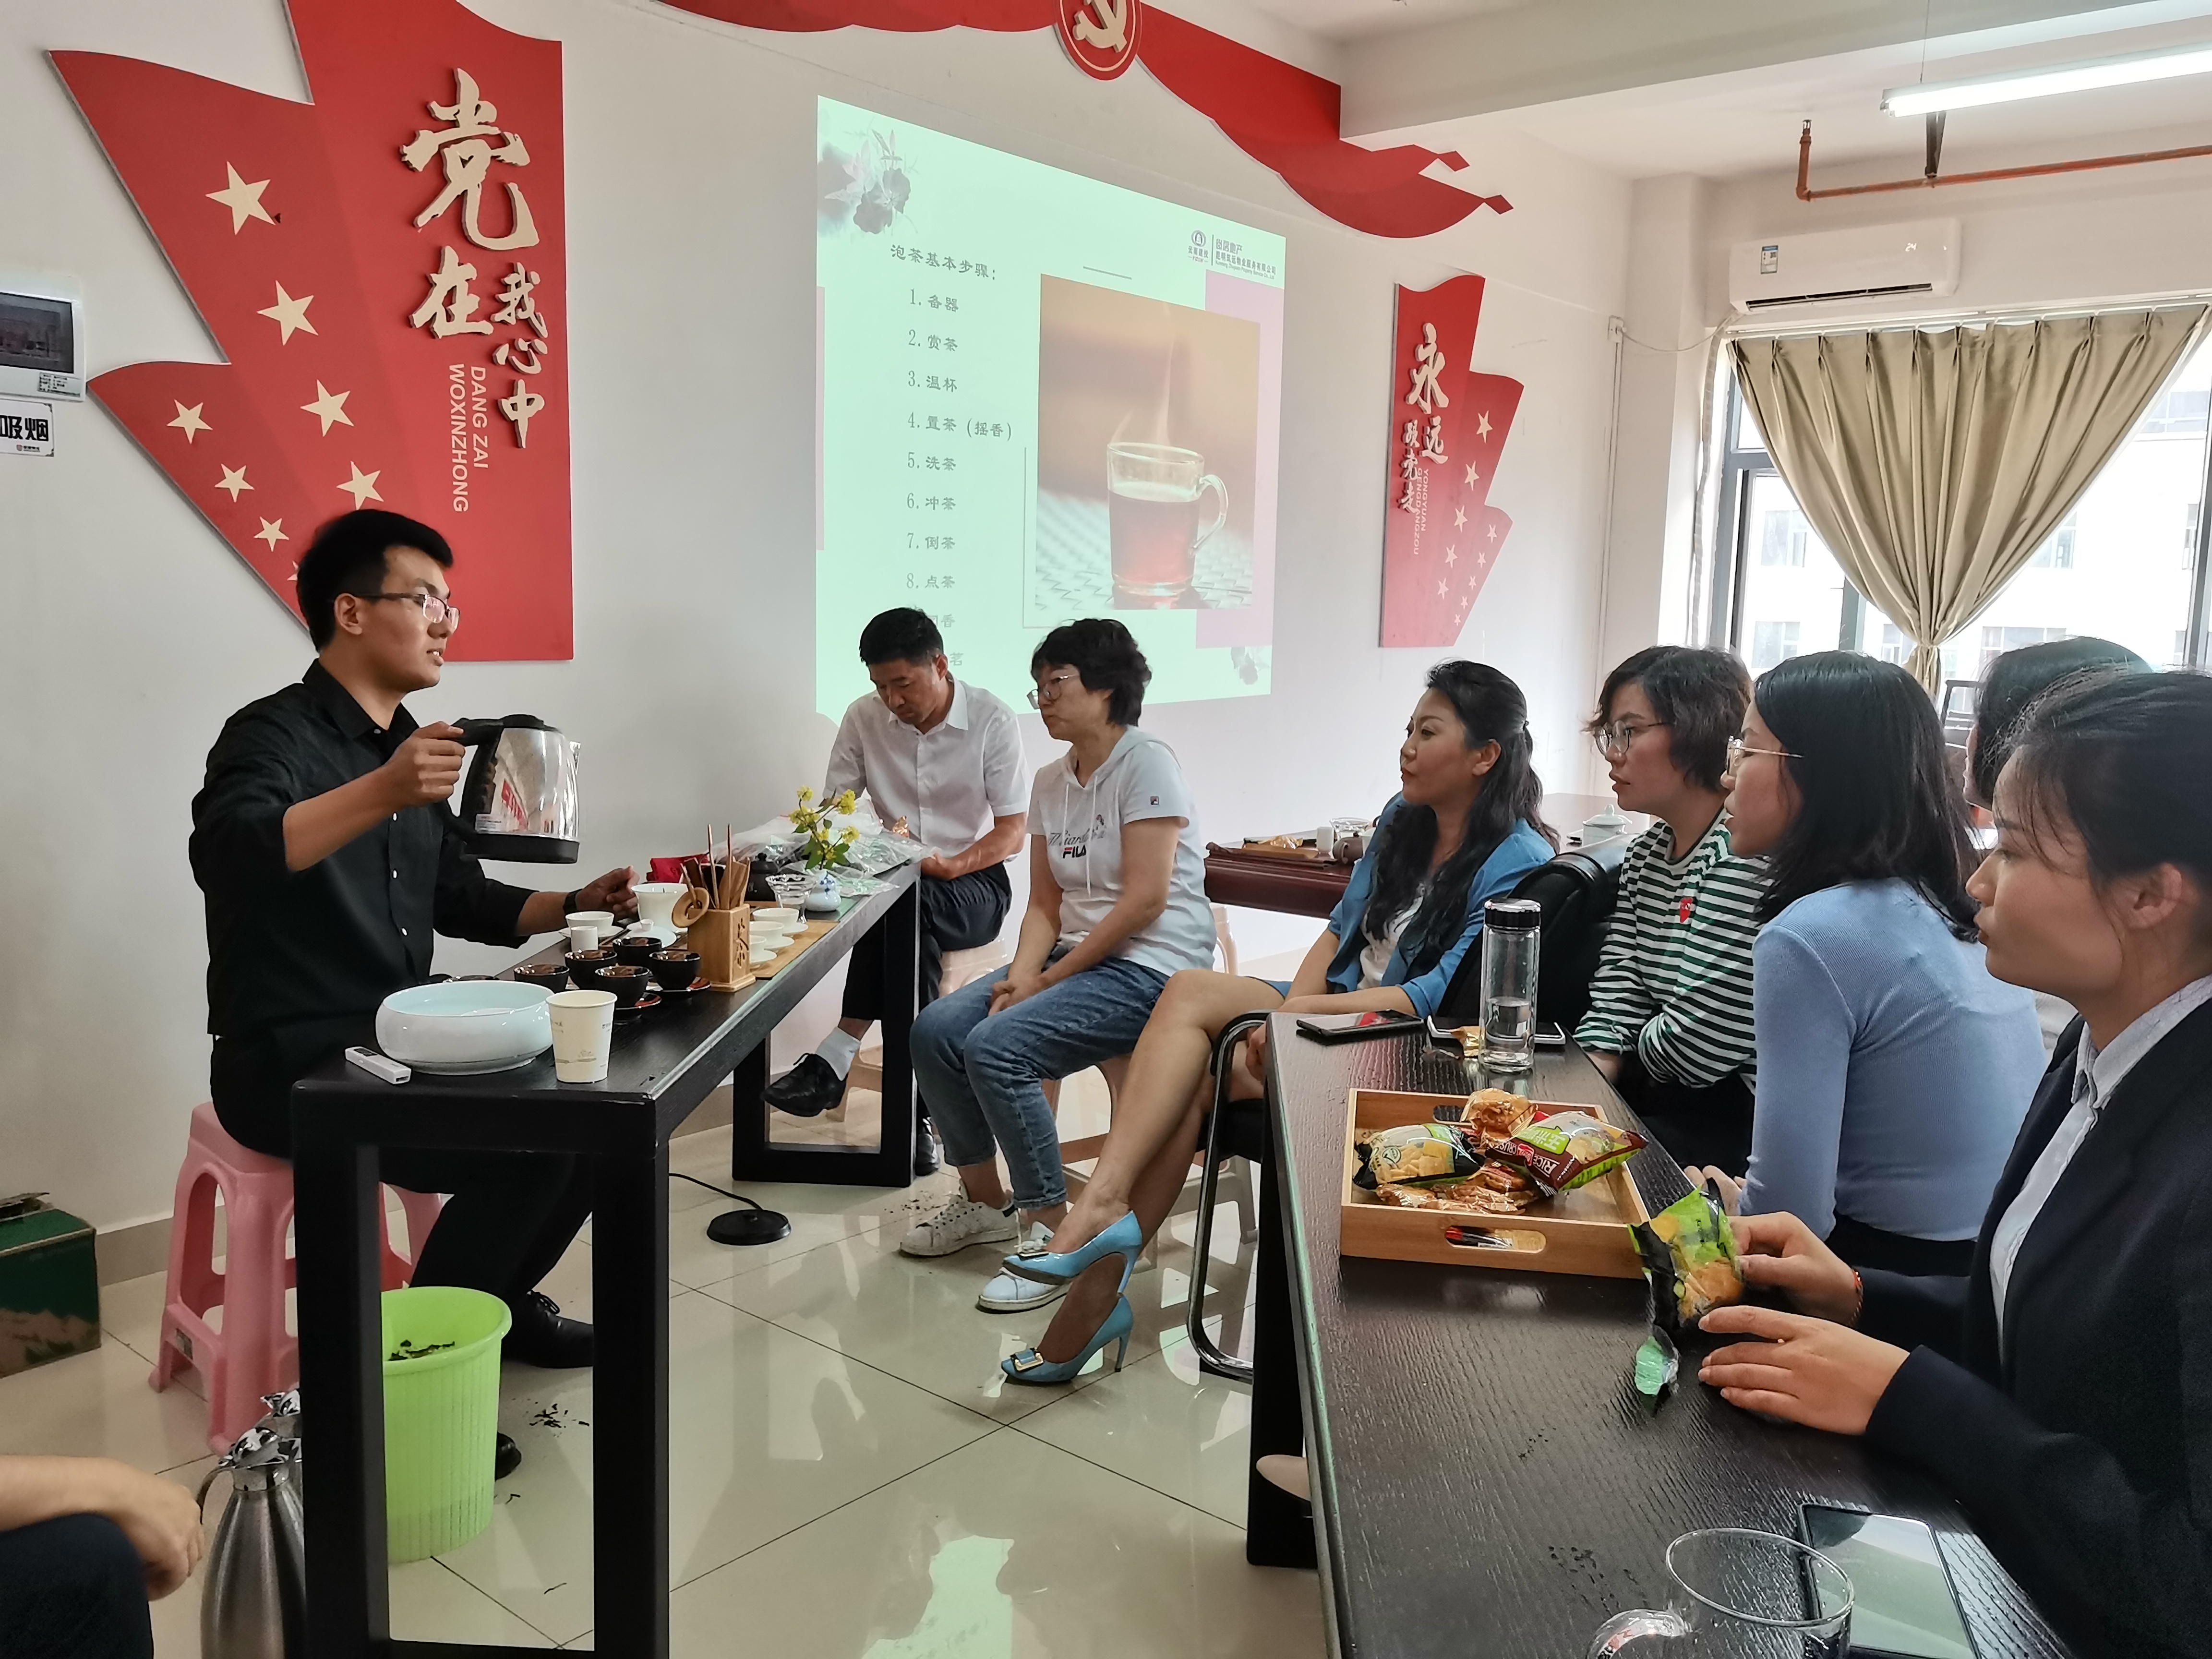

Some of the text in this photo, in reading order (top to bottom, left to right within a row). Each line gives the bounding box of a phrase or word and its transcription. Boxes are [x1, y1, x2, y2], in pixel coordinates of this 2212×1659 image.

[1905, 242, 1917, 252] 24
[910, 288, 959, 312] 1.备器
[908, 328, 958, 351] 2.赏茶
[492, 262, 549, 448] 我心中
[908, 370, 957, 392] 3.温杯
[470, 366, 489, 469] DANG ZAI
[449, 363, 469, 512] WOXINZHONG
[907, 452, 956, 471] 5.洗茶
[907, 493, 956, 511] 6.冲茶
[1413, 467, 1423, 555] GENGDANGZOU
[1421, 469, 1429, 531] YONGYUAN
[906, 573, 955, 589] 8.点茶
[1062, 845, 1087, 859] FILA
[1533, 1154, 1558, 1176] RICE
